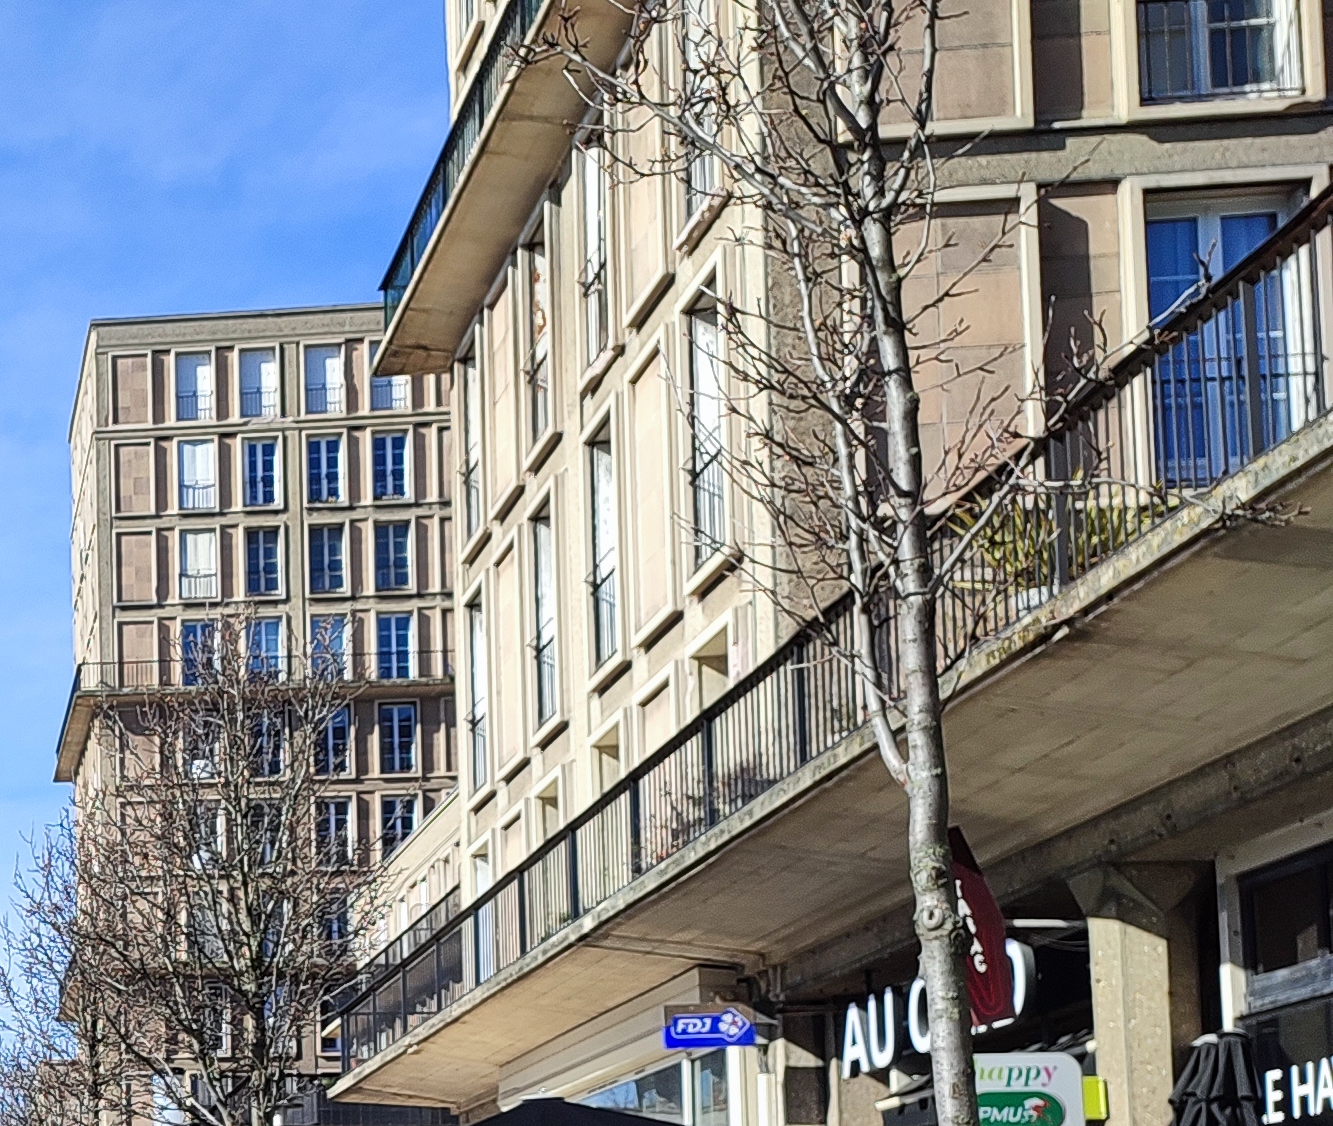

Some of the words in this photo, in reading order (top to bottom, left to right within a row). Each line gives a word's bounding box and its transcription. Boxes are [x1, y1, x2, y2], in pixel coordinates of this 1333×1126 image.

[676, 1017, 713, 1034] FDJ
[841, 986, 895, 1080] AU
[1261, 1068, 1286, 1126] E
[1290, 1054, 1333, 1120] HA
[979, 1105, 1024, 1124] PMU
